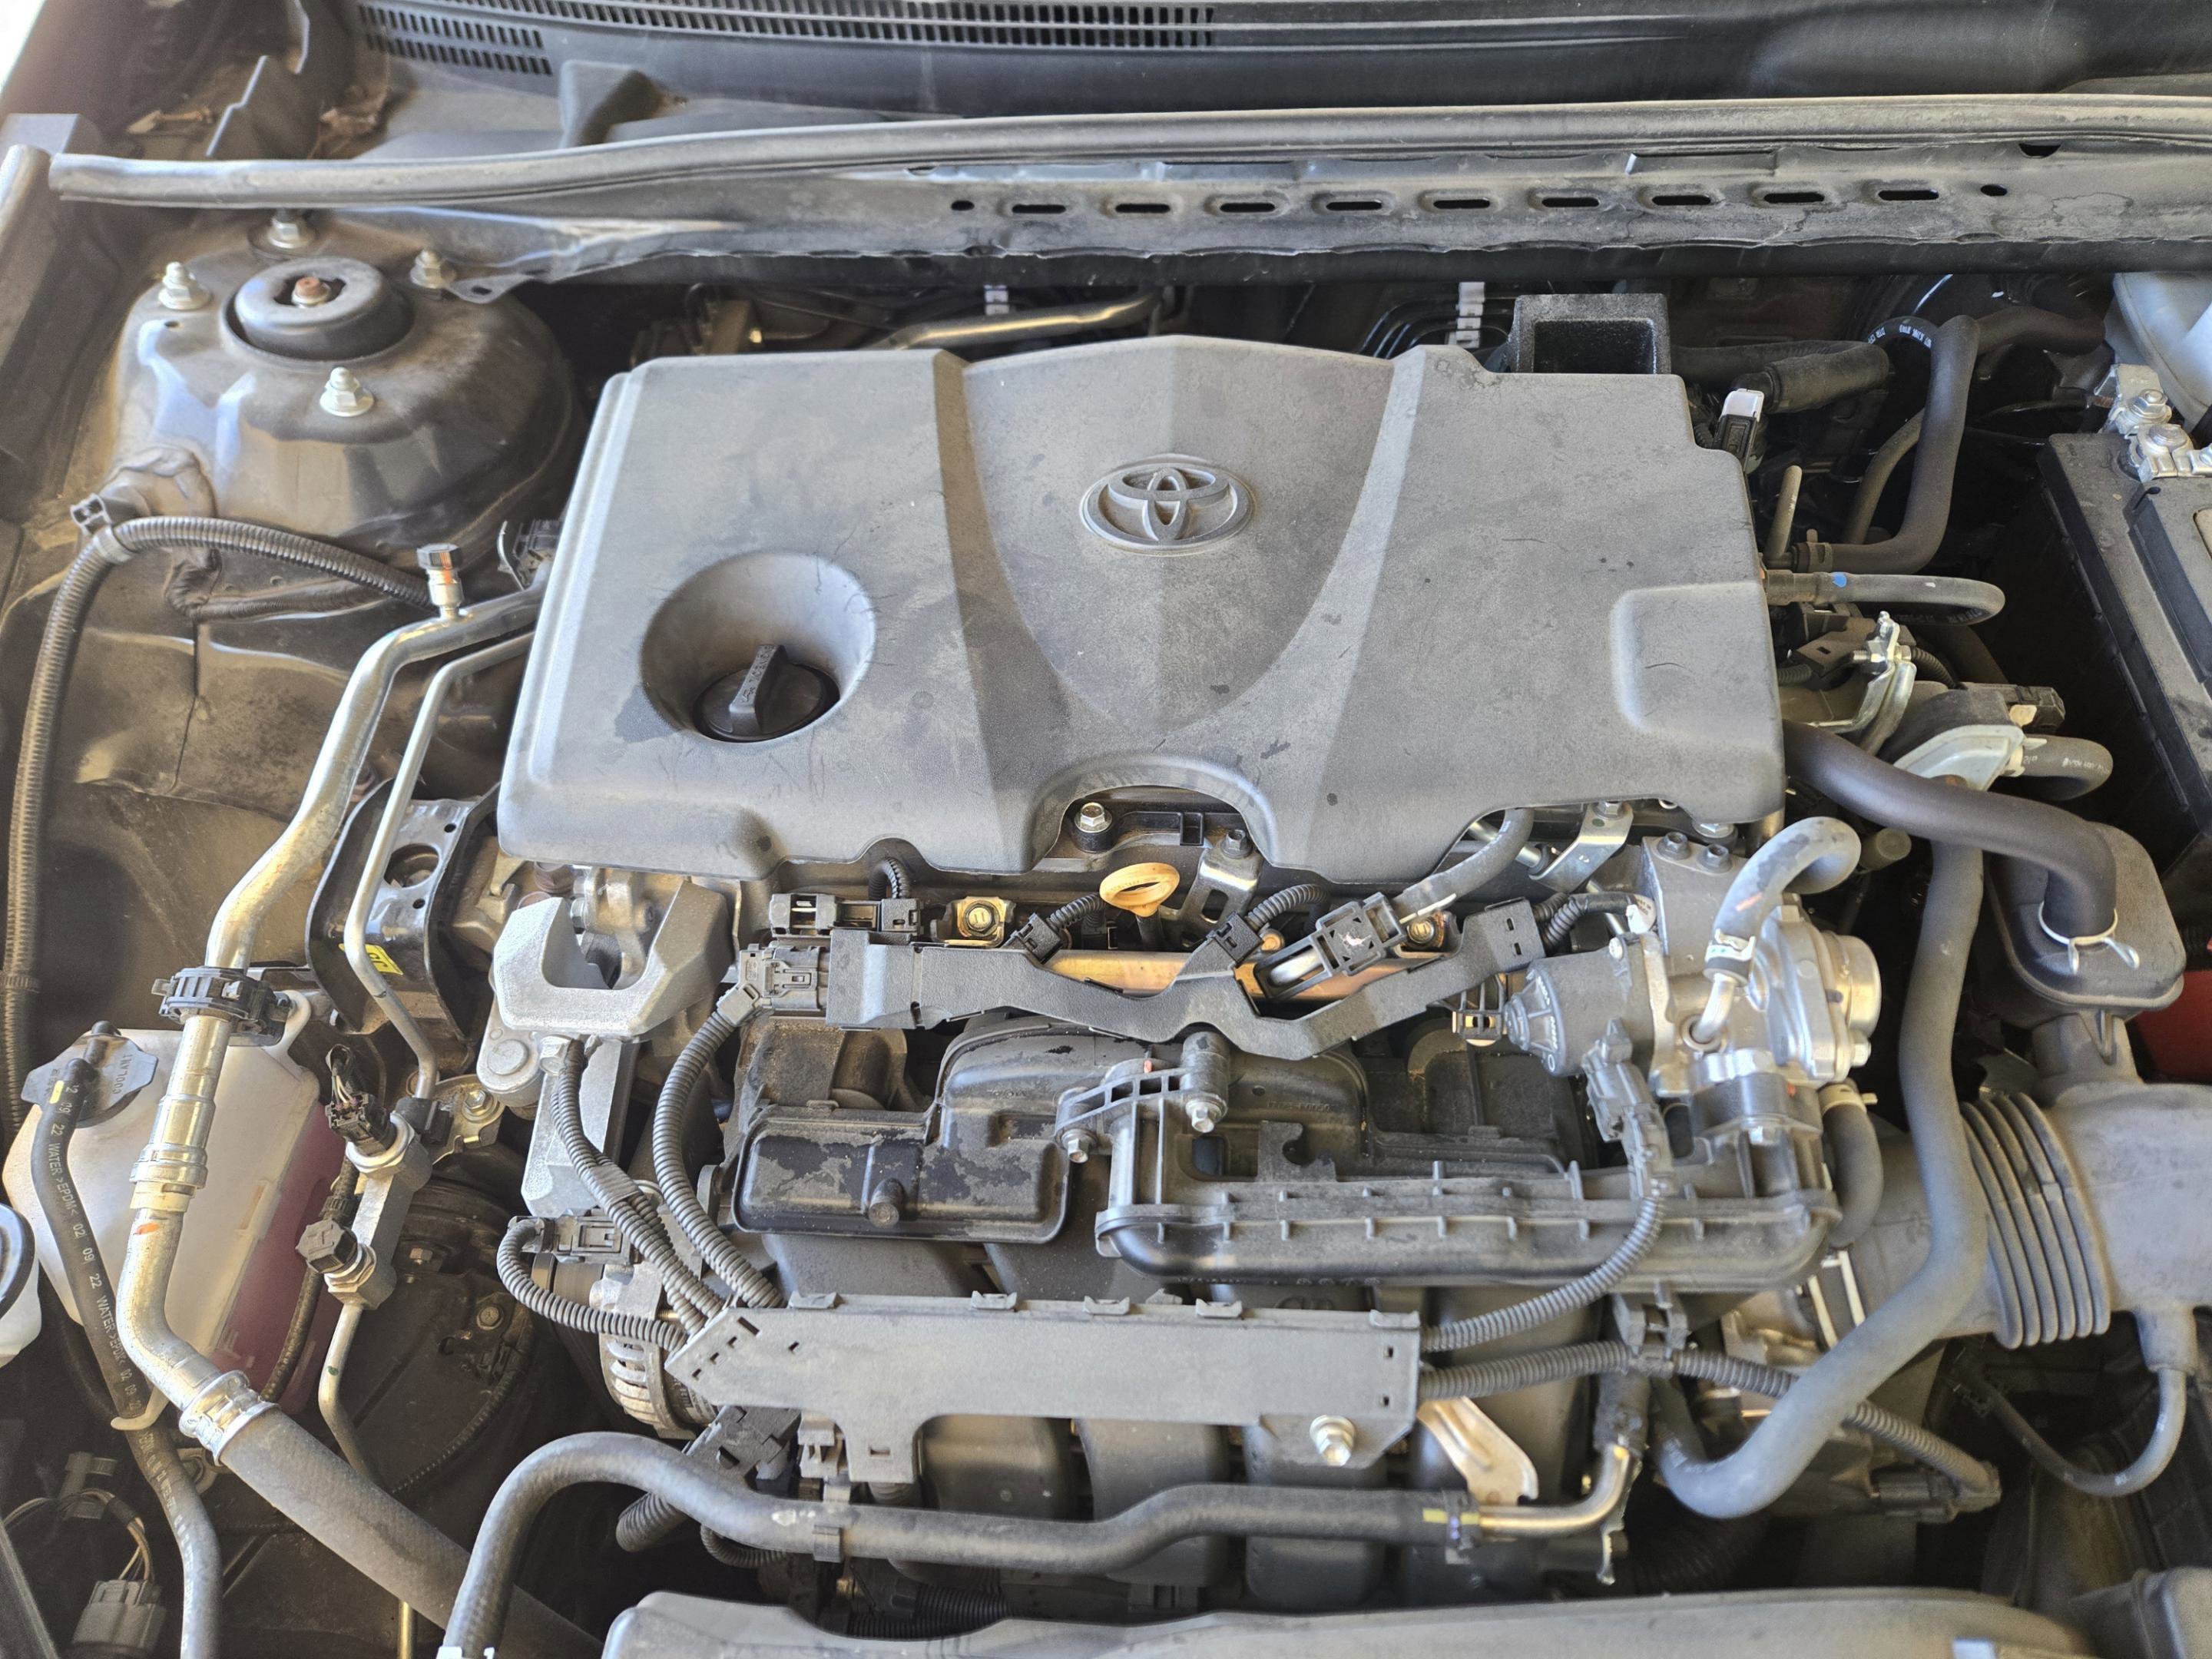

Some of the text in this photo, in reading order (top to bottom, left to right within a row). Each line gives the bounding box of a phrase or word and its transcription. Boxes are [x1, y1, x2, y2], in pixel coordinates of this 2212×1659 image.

[112, 1052, 133, 1094] COOLANT
[51, 1123, 65, 1136] 22
[48, 1143, 63, 1176] WATER
[88, 1273, 103, 1290] 22
[97, 1295, 116, 1333] WATER
